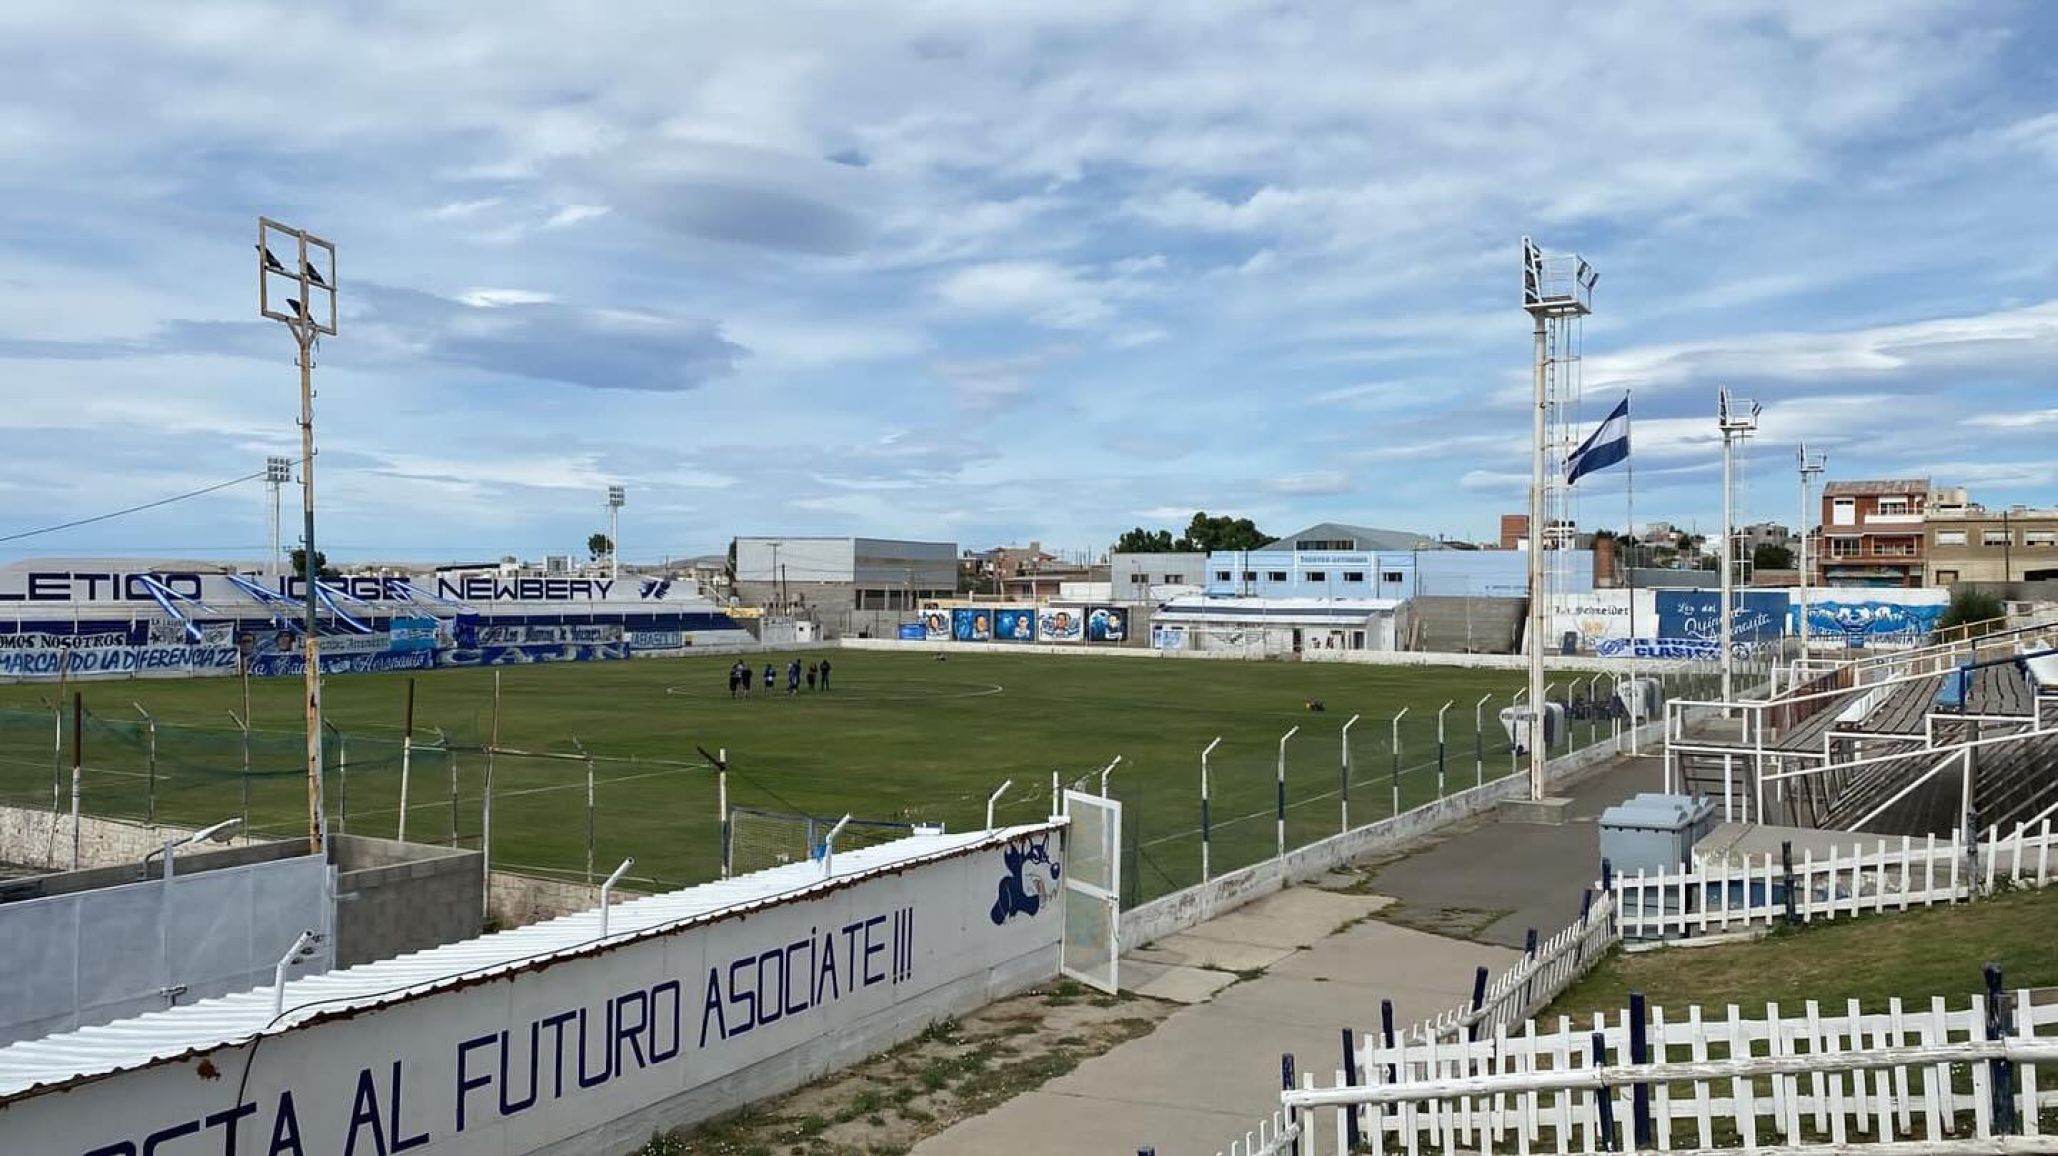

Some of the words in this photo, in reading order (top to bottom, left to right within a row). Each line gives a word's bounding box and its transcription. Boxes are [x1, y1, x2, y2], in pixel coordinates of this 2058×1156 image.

[438, 577, 614, 600] NEWBERY
[40, 633, 124, 649] NOSOTROS
[0, 650, 97, 673] MARCADO
[123, 647, 215, 671] DIFERENCIA
[344, 1060, 430, 1156] AL
[456, 979, 680, 1132] FUTURO
